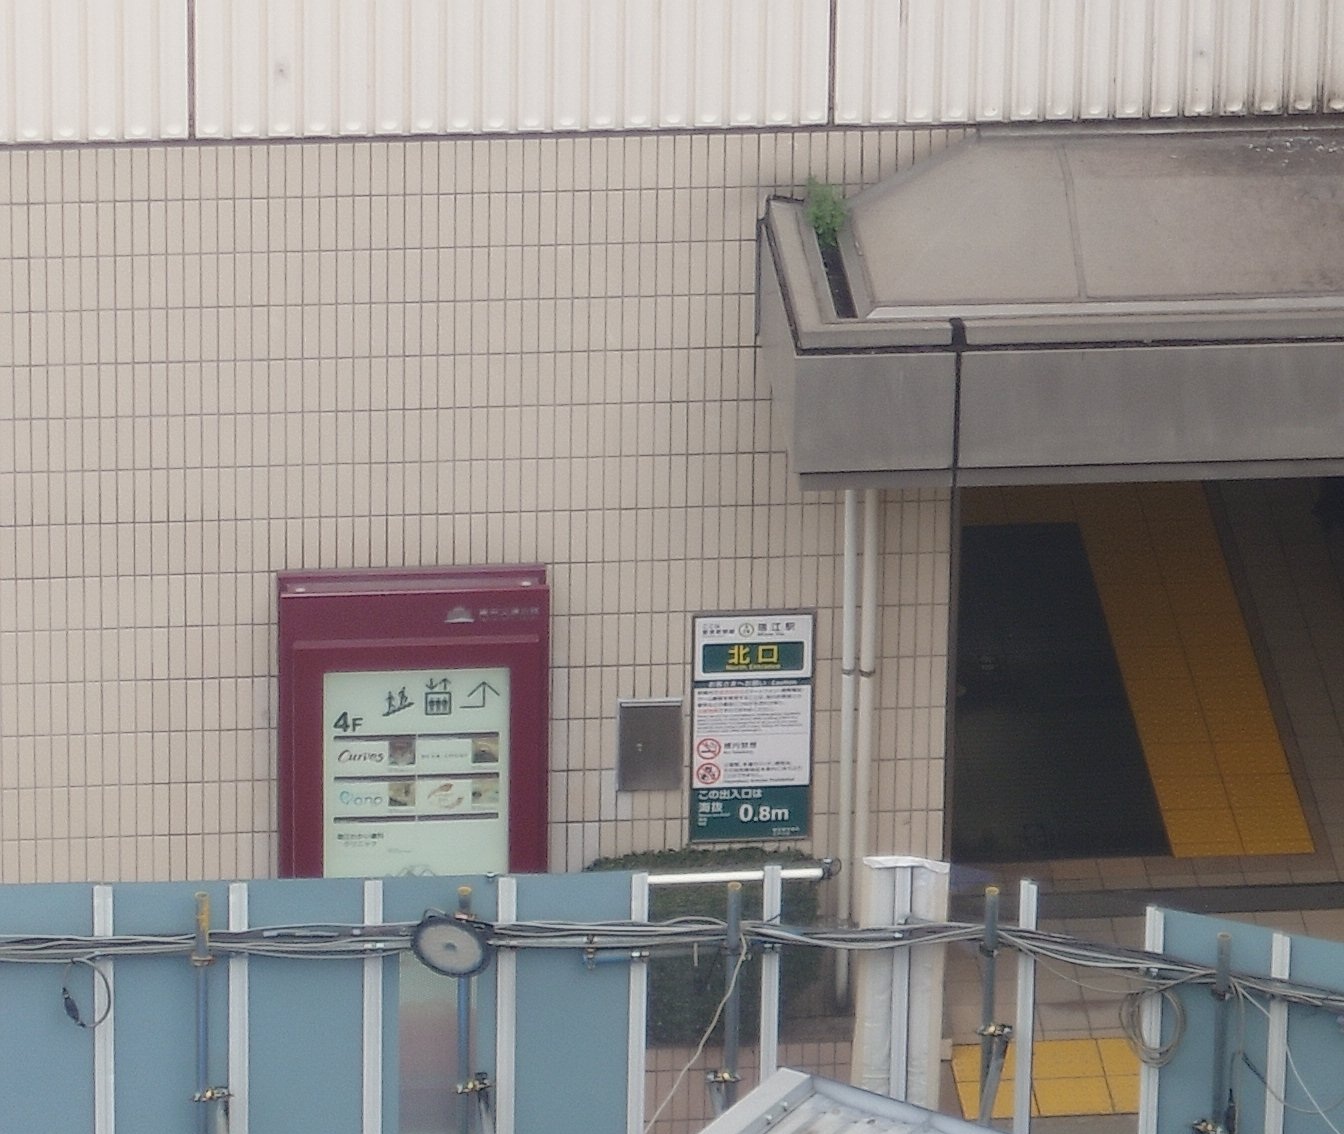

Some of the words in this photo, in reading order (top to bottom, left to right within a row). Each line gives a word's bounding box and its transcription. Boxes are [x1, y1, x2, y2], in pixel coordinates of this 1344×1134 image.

[727, 644, 779, 665] 北口
[333, 711, 363, 732] 4F
[337, 749, 385, 763] Curves
[698, 788, 763, 800] この出入口は
[739, 803, 789, 822] 0.8m
